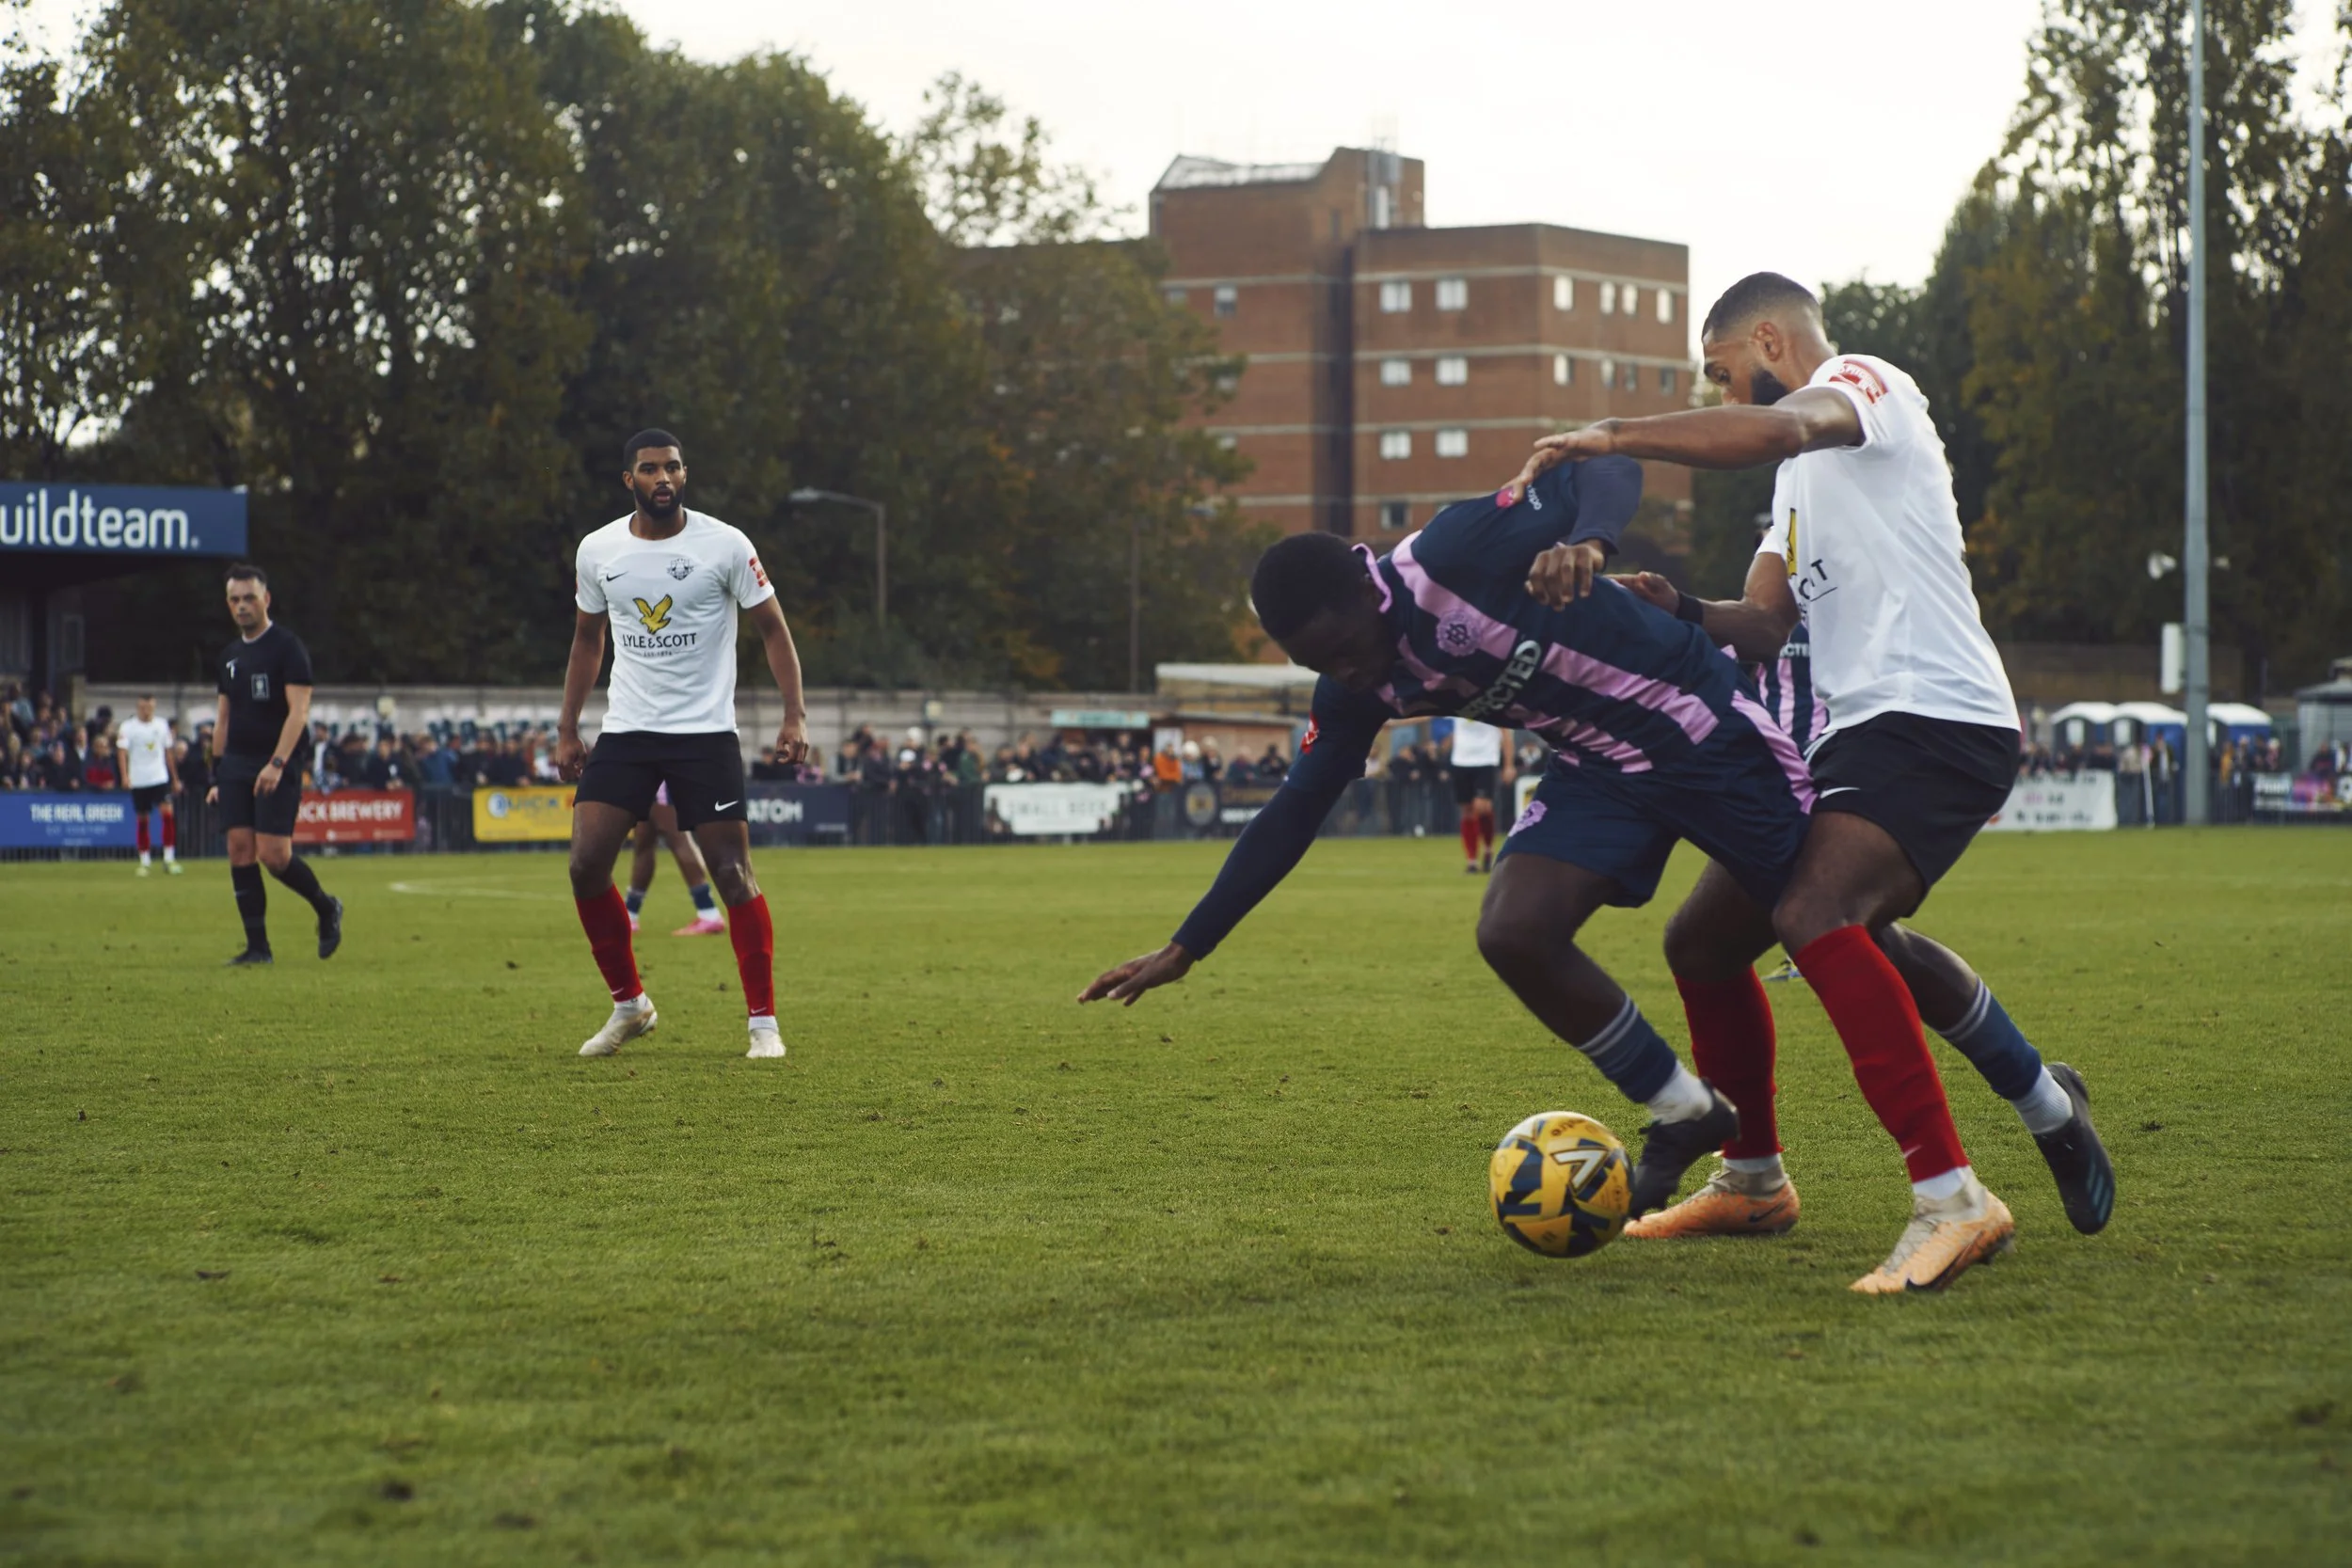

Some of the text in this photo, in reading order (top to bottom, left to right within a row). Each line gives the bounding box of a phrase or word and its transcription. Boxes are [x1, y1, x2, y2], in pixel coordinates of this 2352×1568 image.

[623, 634, 646, 648] LYLE
[656, 632, 697, 648] SCOTT
[30, 803, 53, 823] THE
[54, 803, 85, 823] REAL
[329, 799, 404, 823] BREWERY
